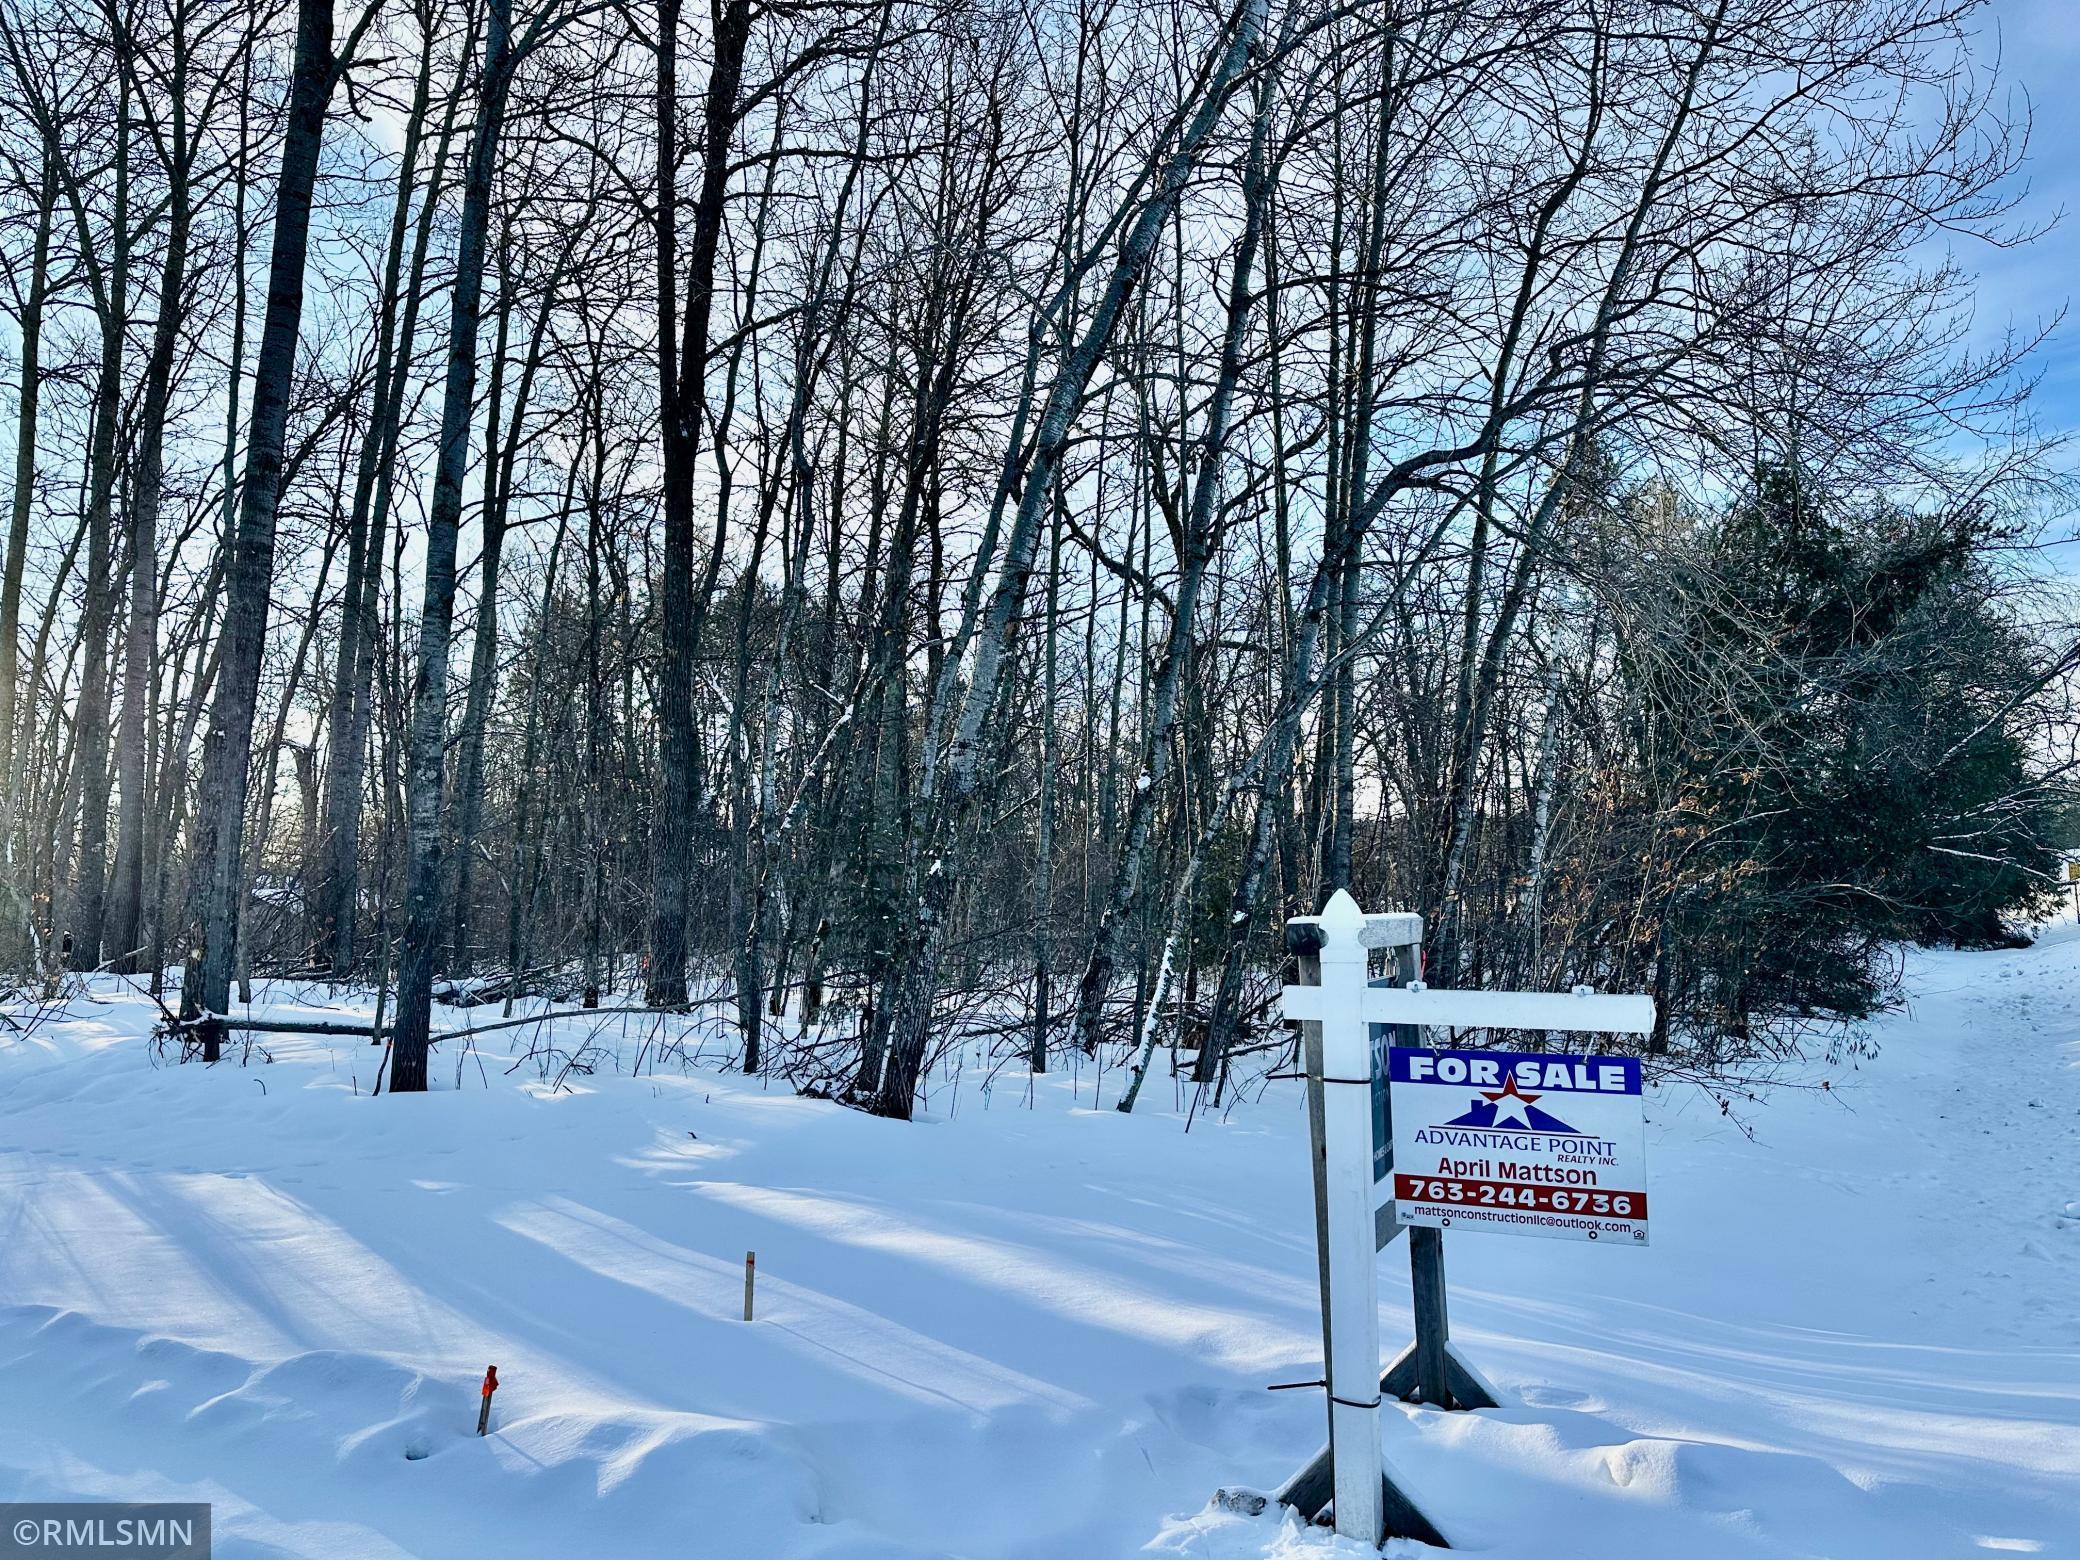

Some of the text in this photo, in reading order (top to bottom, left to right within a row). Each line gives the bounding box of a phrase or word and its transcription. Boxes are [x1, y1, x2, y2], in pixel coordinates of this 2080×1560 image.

[1409, 1056, 1625, 1091] FOR SALE
[1415, 1130, 1541, 1151] ADVANTAGE
[1549, 1138, 1617, 1156] POINT
[1438, 1157, 1597, 1185] April Mattson
[1557, 1154, 1619, 1166] REALTY INC.
[1409, 1179, 1632, 1215] 763-244-6736
[1414, 1205, 1631, 1233] mattsonconstructionllc@outlook.com
